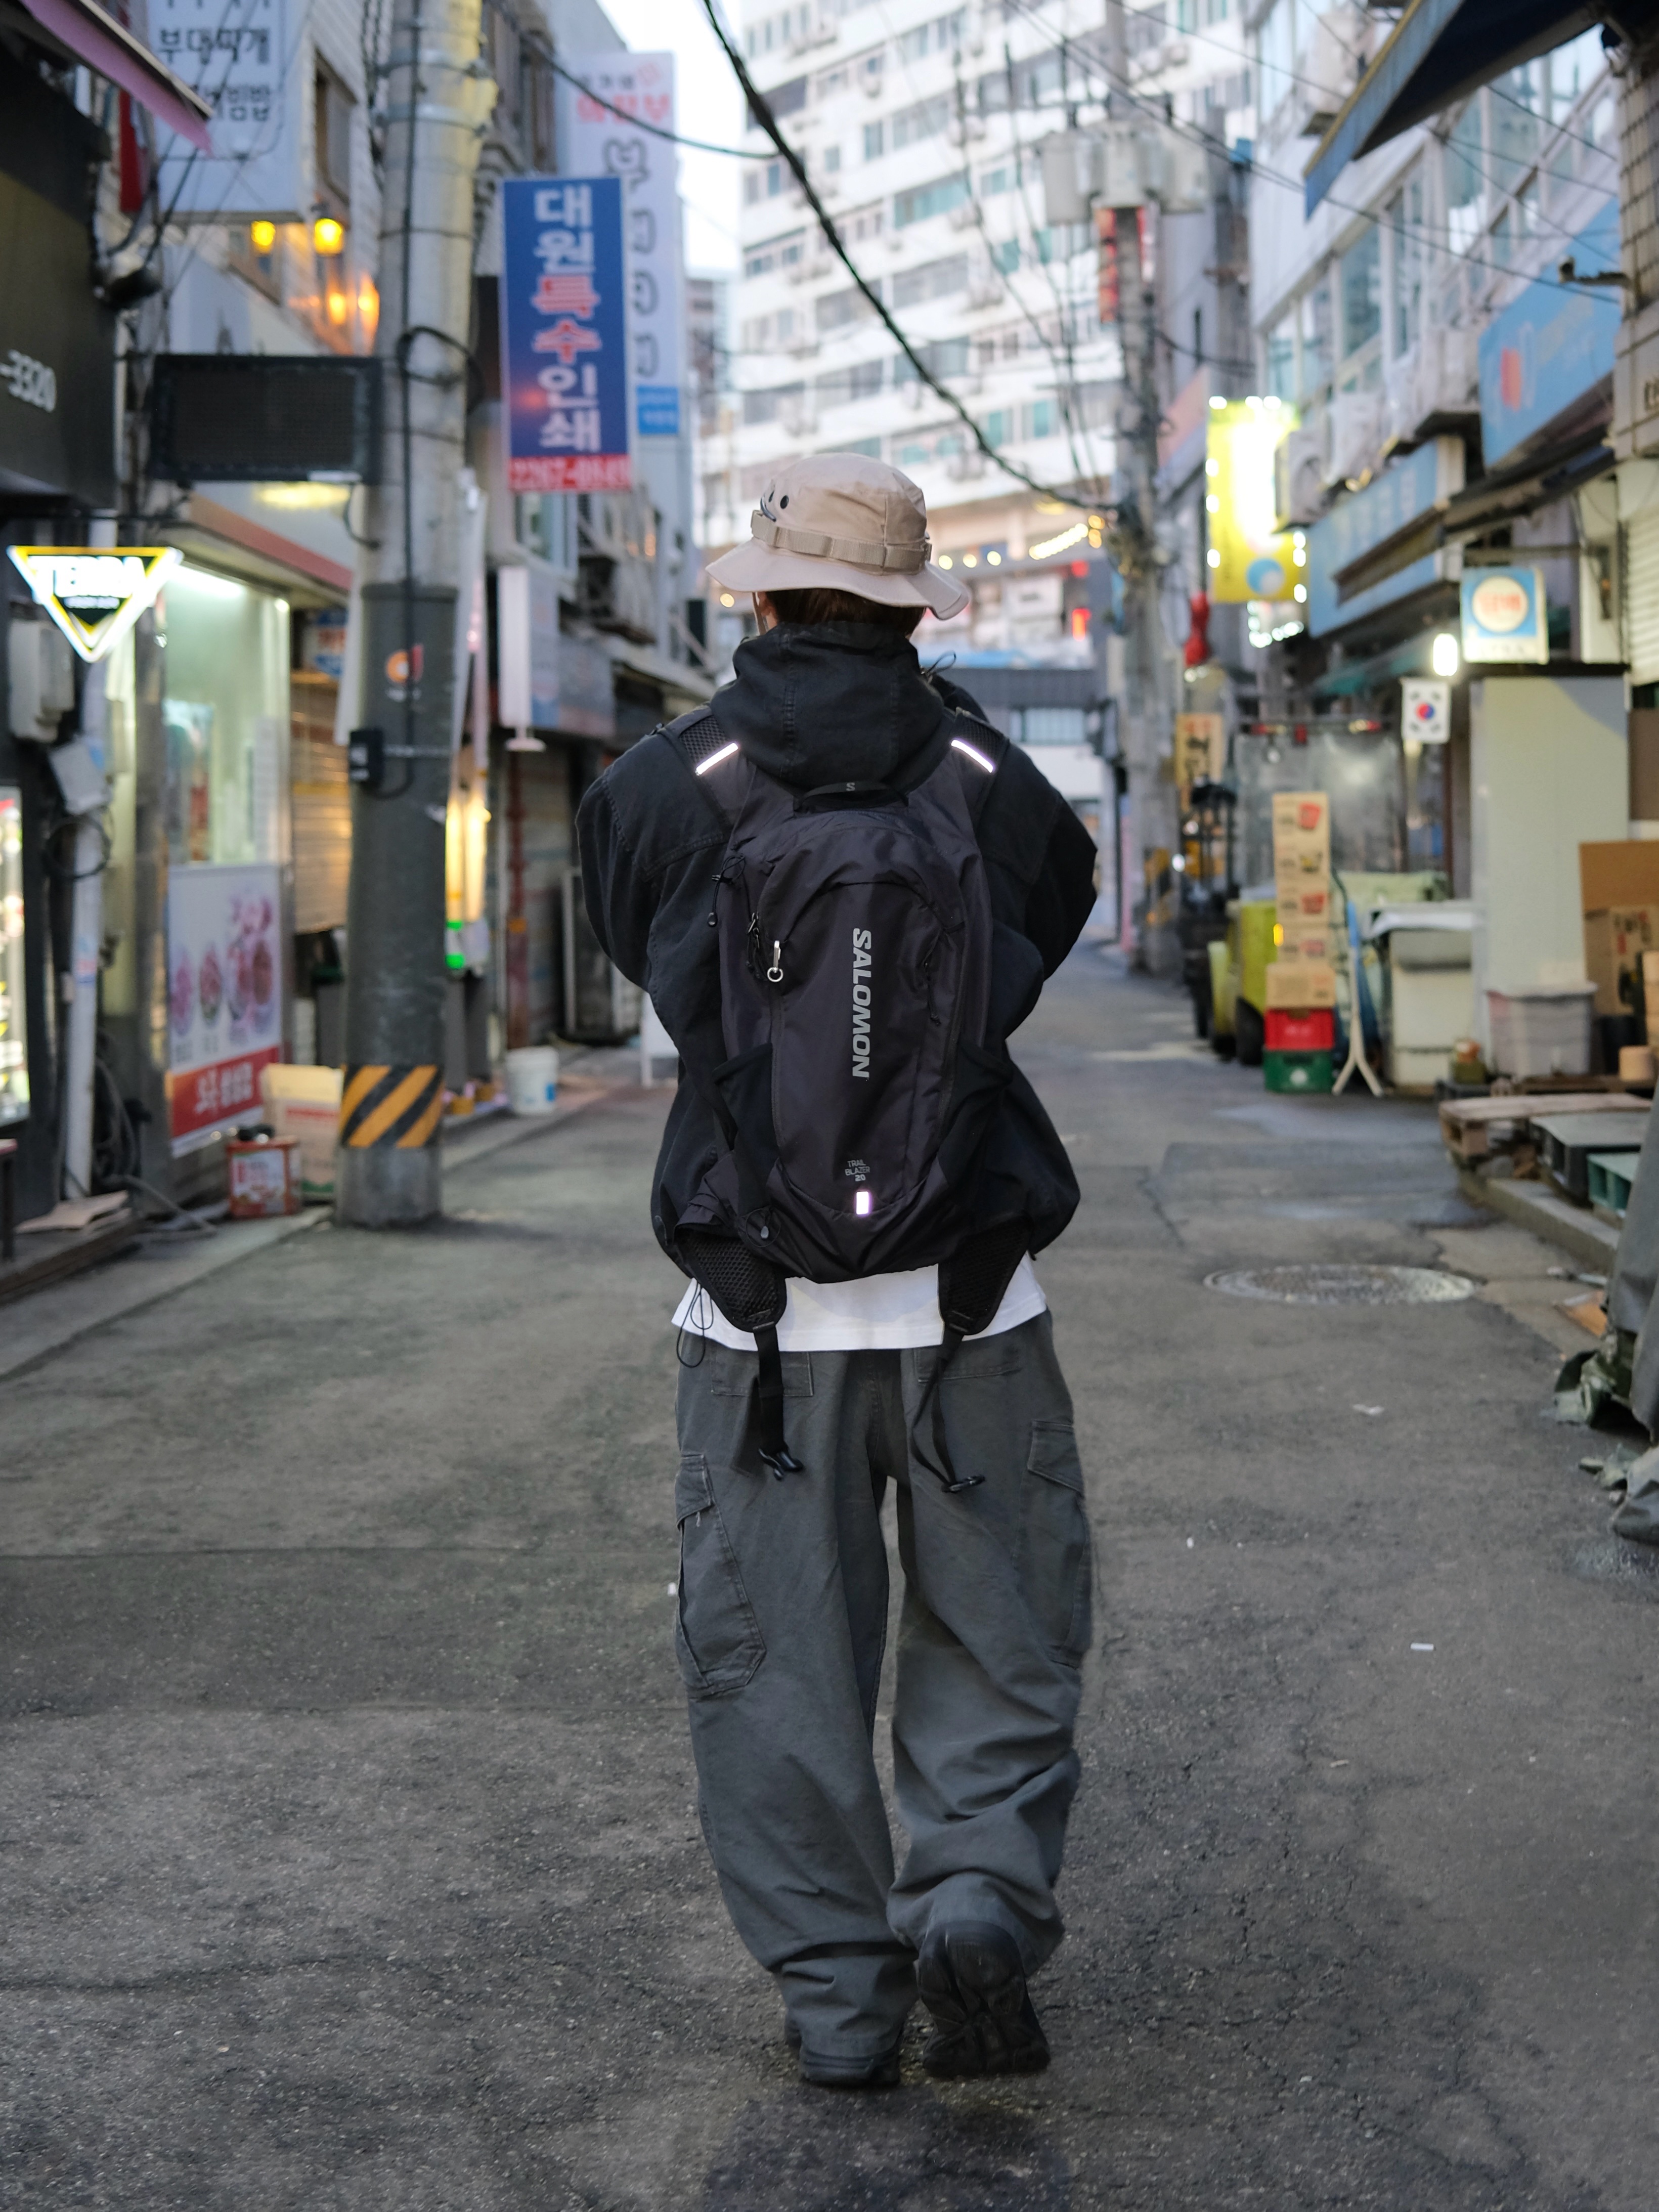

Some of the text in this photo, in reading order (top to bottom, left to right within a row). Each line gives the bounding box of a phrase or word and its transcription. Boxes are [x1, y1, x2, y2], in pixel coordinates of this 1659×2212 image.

[852, 928, 871, 1078] SALOMON
[847, 1159, 866, 1167] TRAIL
[844, 1166, 870, 1176] BLAZER
